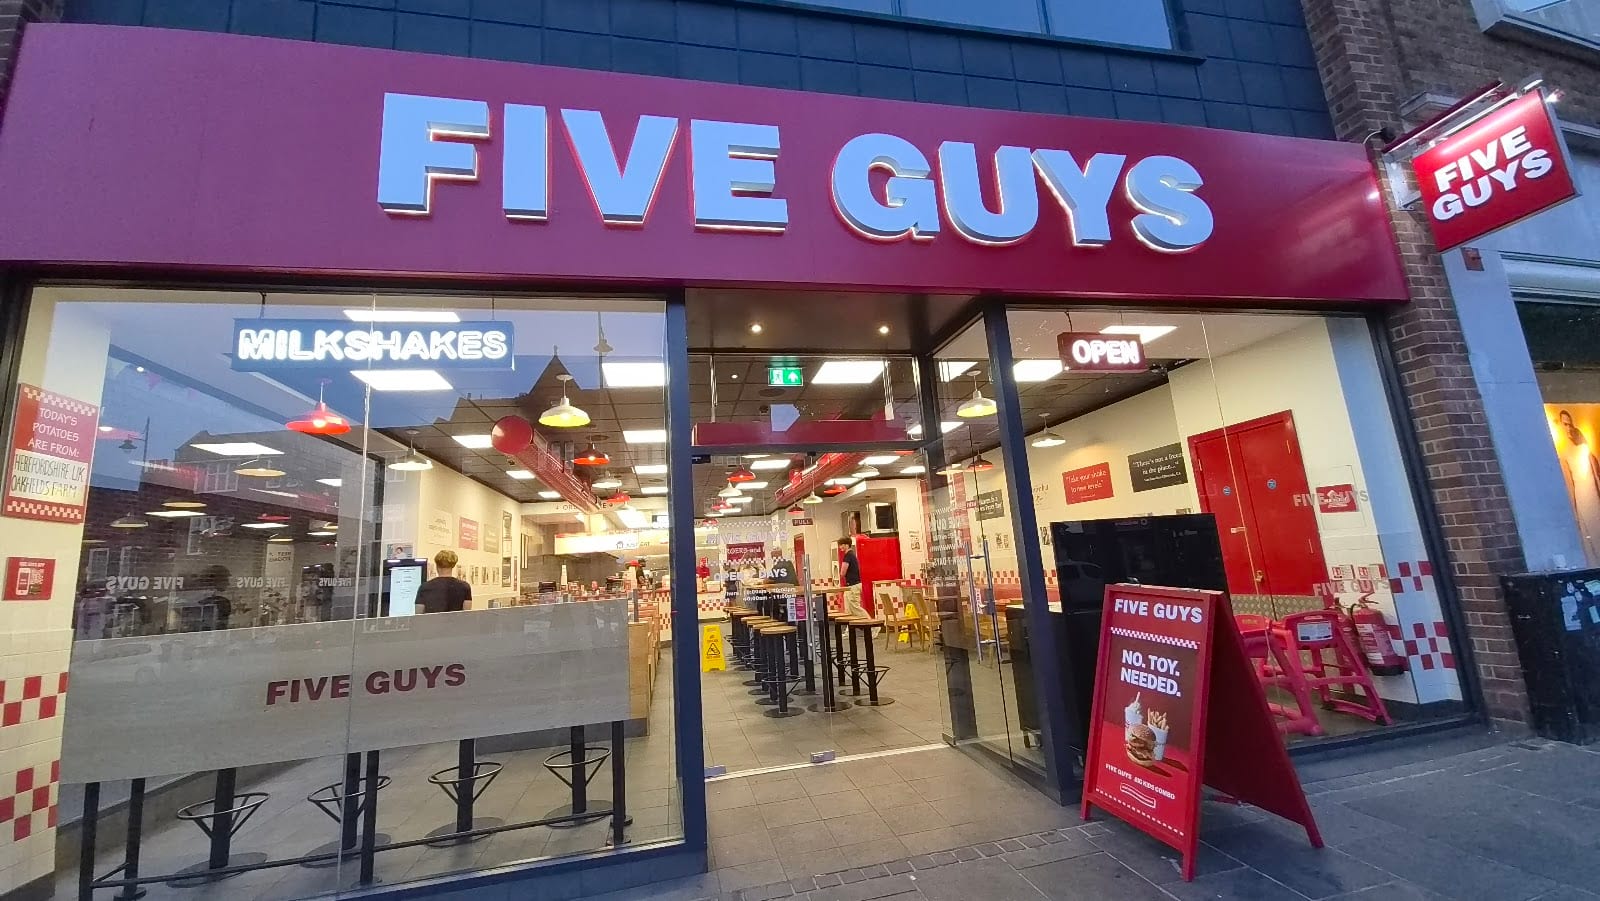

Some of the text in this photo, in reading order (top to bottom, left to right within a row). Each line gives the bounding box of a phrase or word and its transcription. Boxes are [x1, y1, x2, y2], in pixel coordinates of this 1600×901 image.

[377, 92, 1214, 253] FIVE GUYS
[1433, 125, 1533, 193] FIVE
[1432, 148, 1553, 221] GUYS
[237, 328, 508, 361] MILKSHAKES
[1072, 339, 1141, 364] OPEN
[39, 407, 78, 426] TODAY'S
[32, 422, 79, 442] POTATOES
[27, 437, 80, 457] ARE FROM:
[1293, 492, 1325, 507] FIVE
[758, 568, 788, 579] DAYS
[1312, 579, 1345, 597] FIVE
[1114, 598, 1203, 624] FIVE GUYS
[1121, 649, 1180, 677] NO. TOY.
[266, 663, 466, 706] FIVE GUYS
[1120, 667, 1181, 697] NEEDED.
[1105, 763, 1176, 800] FIVE GUYS BIG KIDS COMBO
